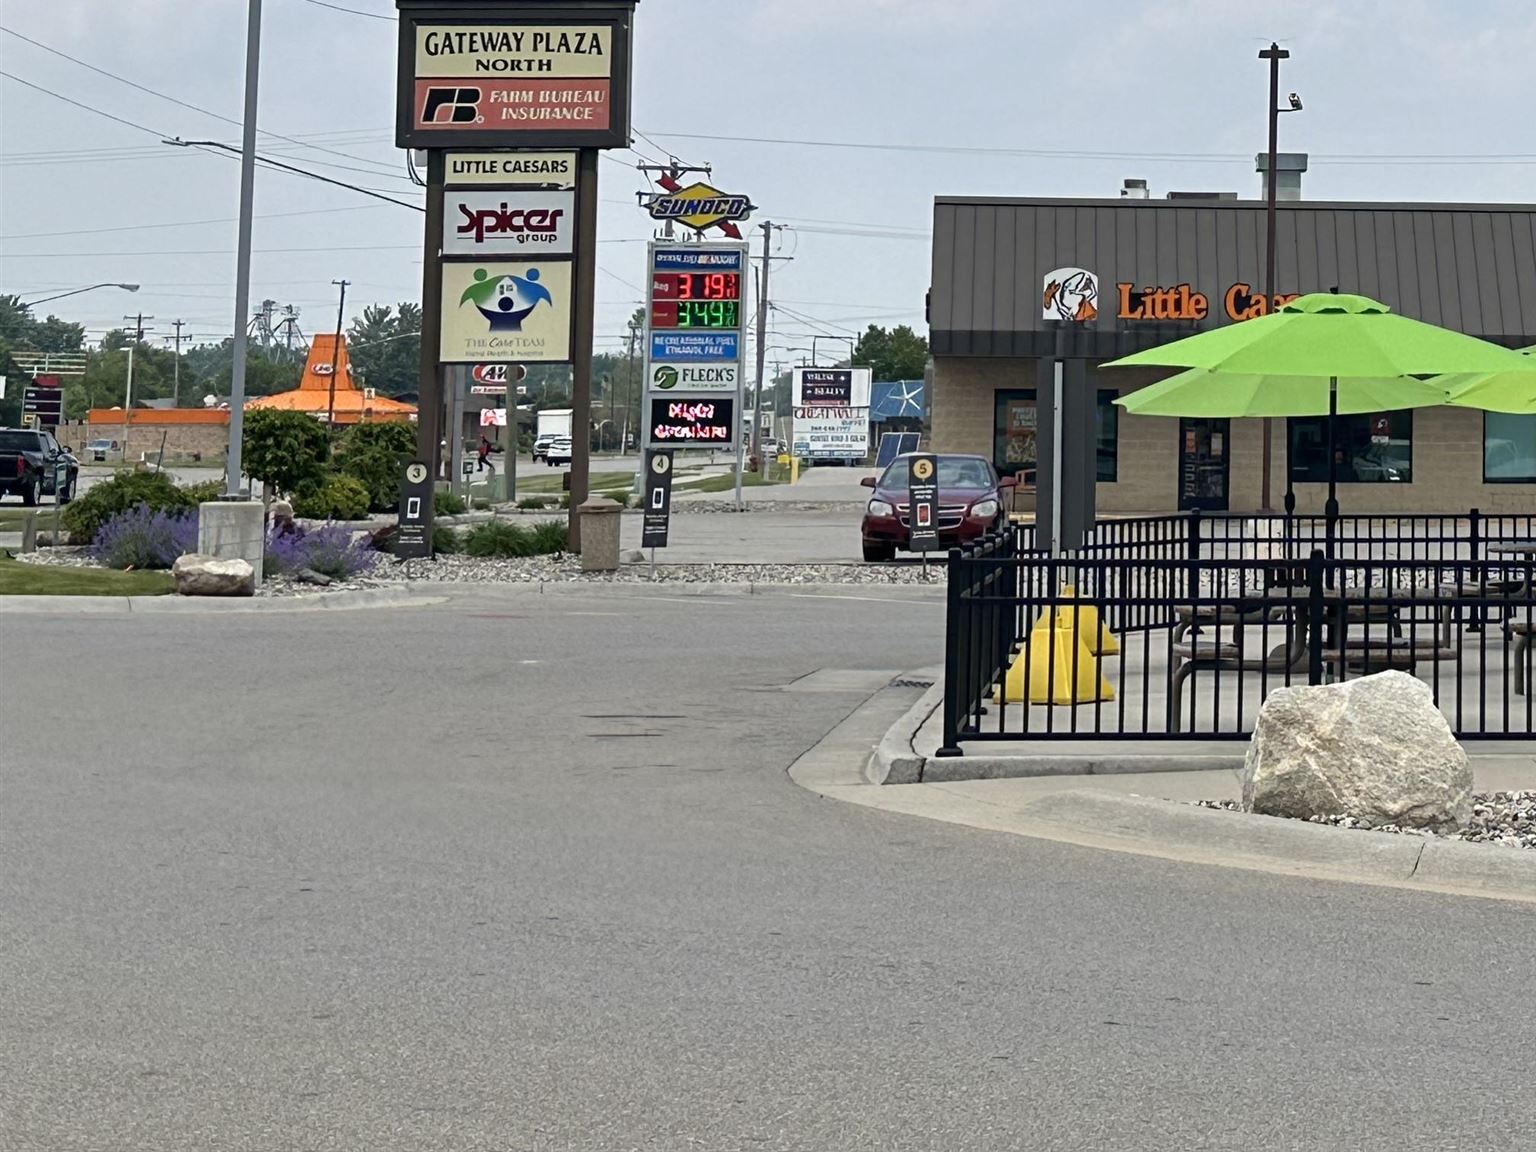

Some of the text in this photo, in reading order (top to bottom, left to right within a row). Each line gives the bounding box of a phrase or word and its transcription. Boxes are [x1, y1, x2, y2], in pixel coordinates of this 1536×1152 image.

[425, 32, 603, 56] GATEWAY PLAZA
[475, 59, 552, 72] NORTH
[489, 90, 606, 103] FARM BUREAU
[501, 106, 594, 120] INSURANCE
[453, 160, 569, 174] LITTLE CAESARS
[653, 198, 745, 216] SUNOCO
[516, 233, 558, 244] group
[1116, 282, 1209, 320] Little
[682, 368, 735, 382] FLECK'S
[412, 467, 422, 479] 3
[919, 463, 928, 475] 5
